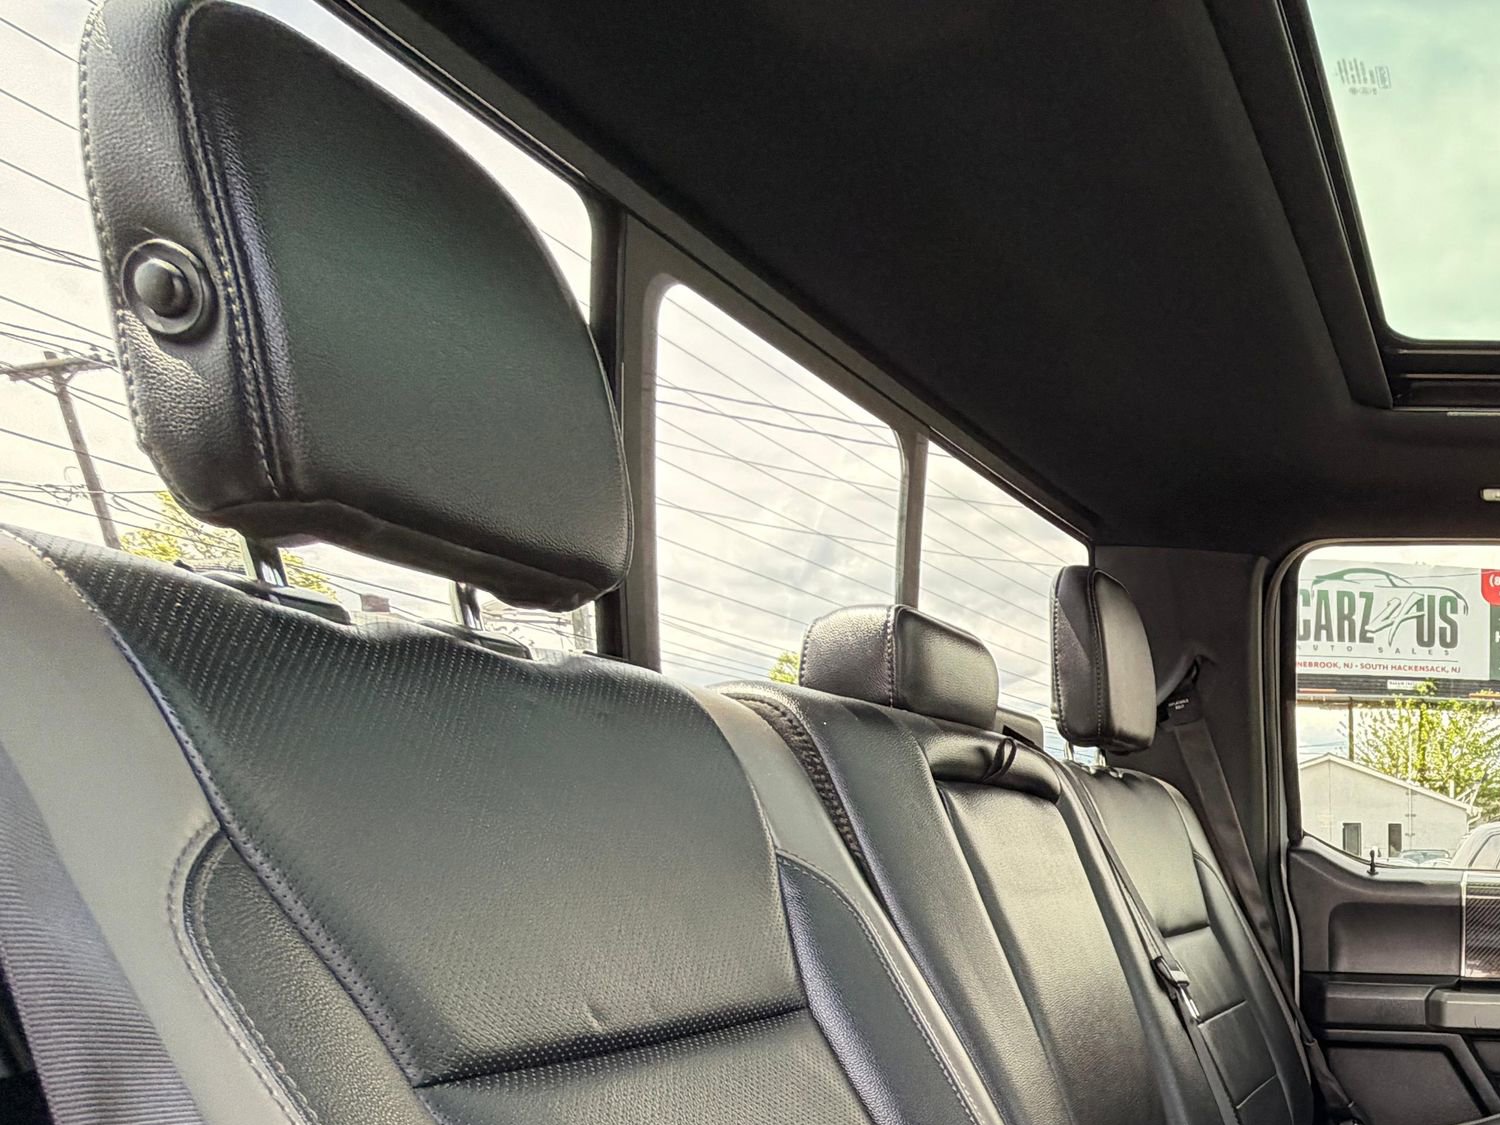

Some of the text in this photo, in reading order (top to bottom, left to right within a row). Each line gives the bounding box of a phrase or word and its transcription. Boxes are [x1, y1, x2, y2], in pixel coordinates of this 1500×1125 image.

[1378, 646, 1449, 656] SALES
[1360, 662, 1389, 671] SOUTH
[1391, 664, 1449, 673] HACKENSACK,
[1451, 666, 1461, 674] NJ
